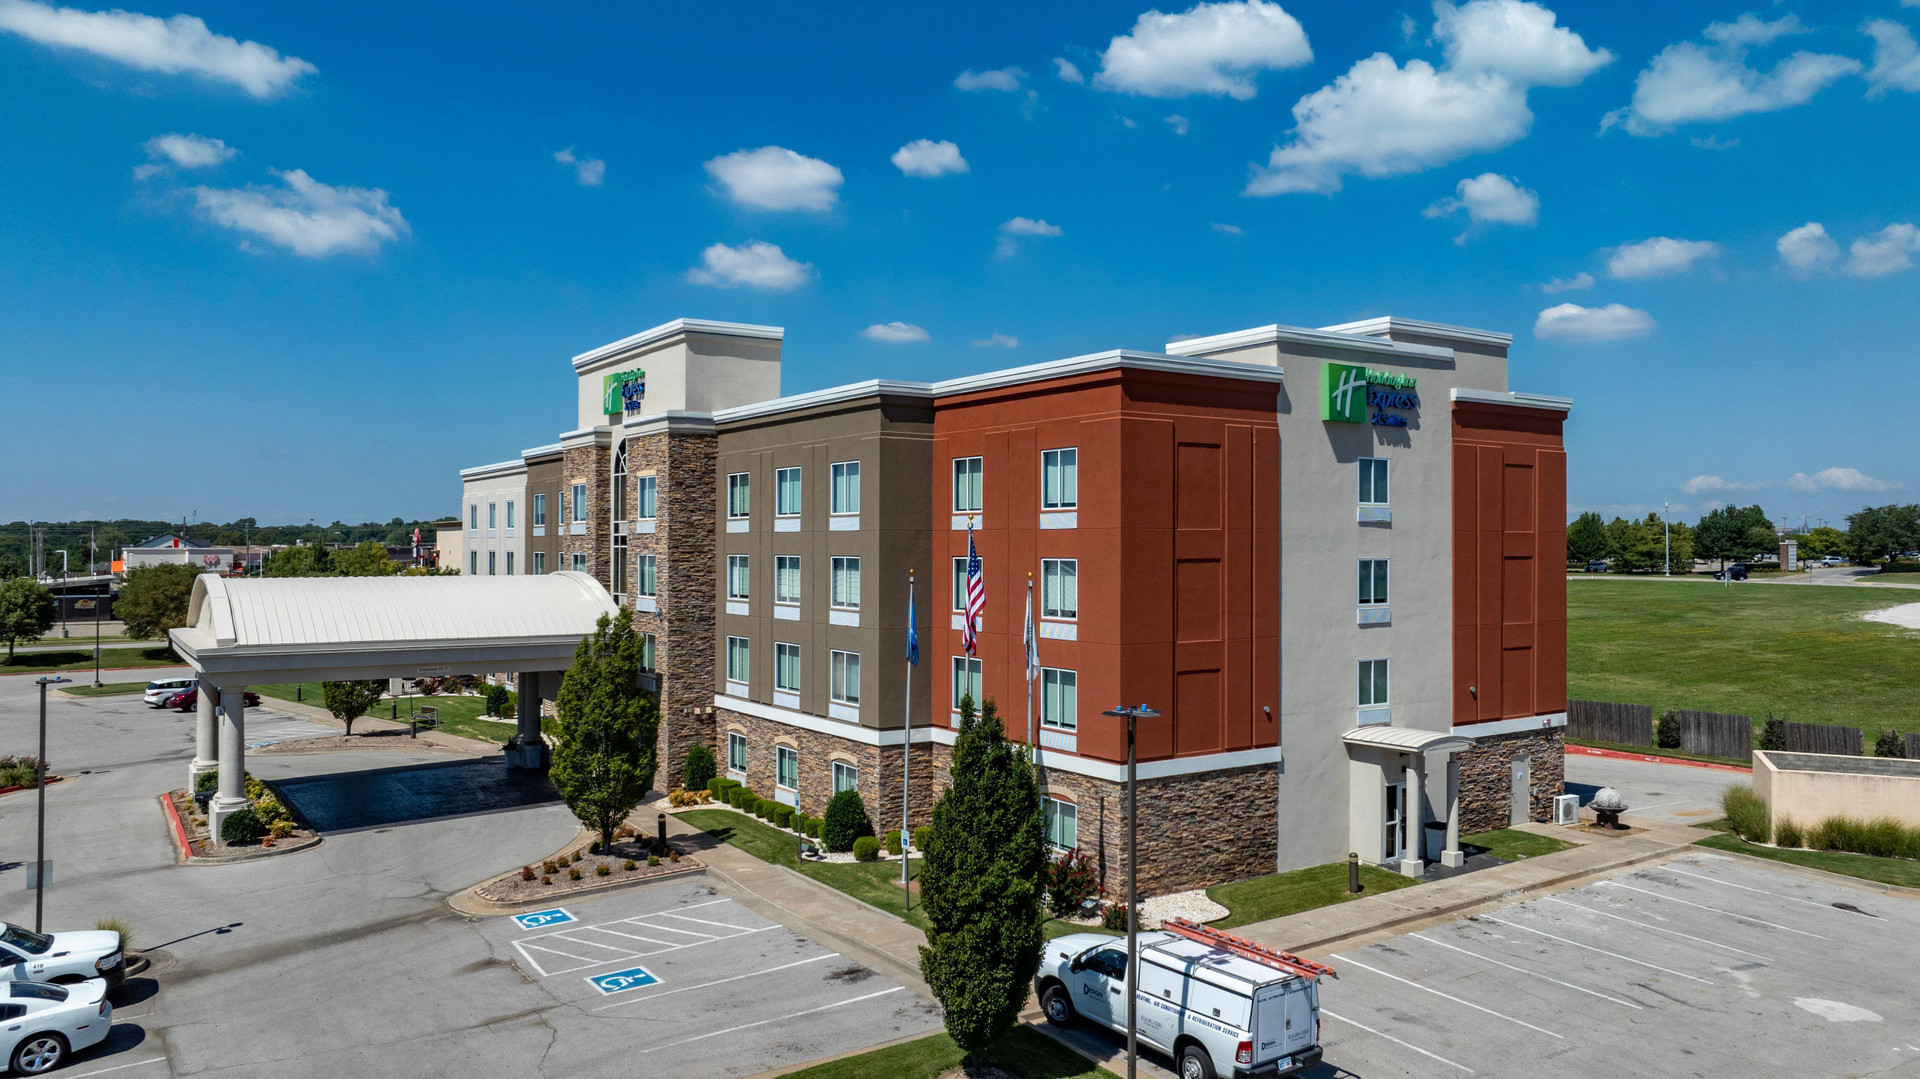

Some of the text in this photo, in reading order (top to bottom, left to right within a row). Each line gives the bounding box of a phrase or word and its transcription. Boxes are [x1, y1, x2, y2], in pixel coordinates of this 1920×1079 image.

[1366, 368, 1418, 390] Holiday Inn
[1366, 386, 1418, 411] Express
[1191, 1015, 1222, 1032] REFRIGERATION
[1222, 1027, 1240, 1038] SERVICE
